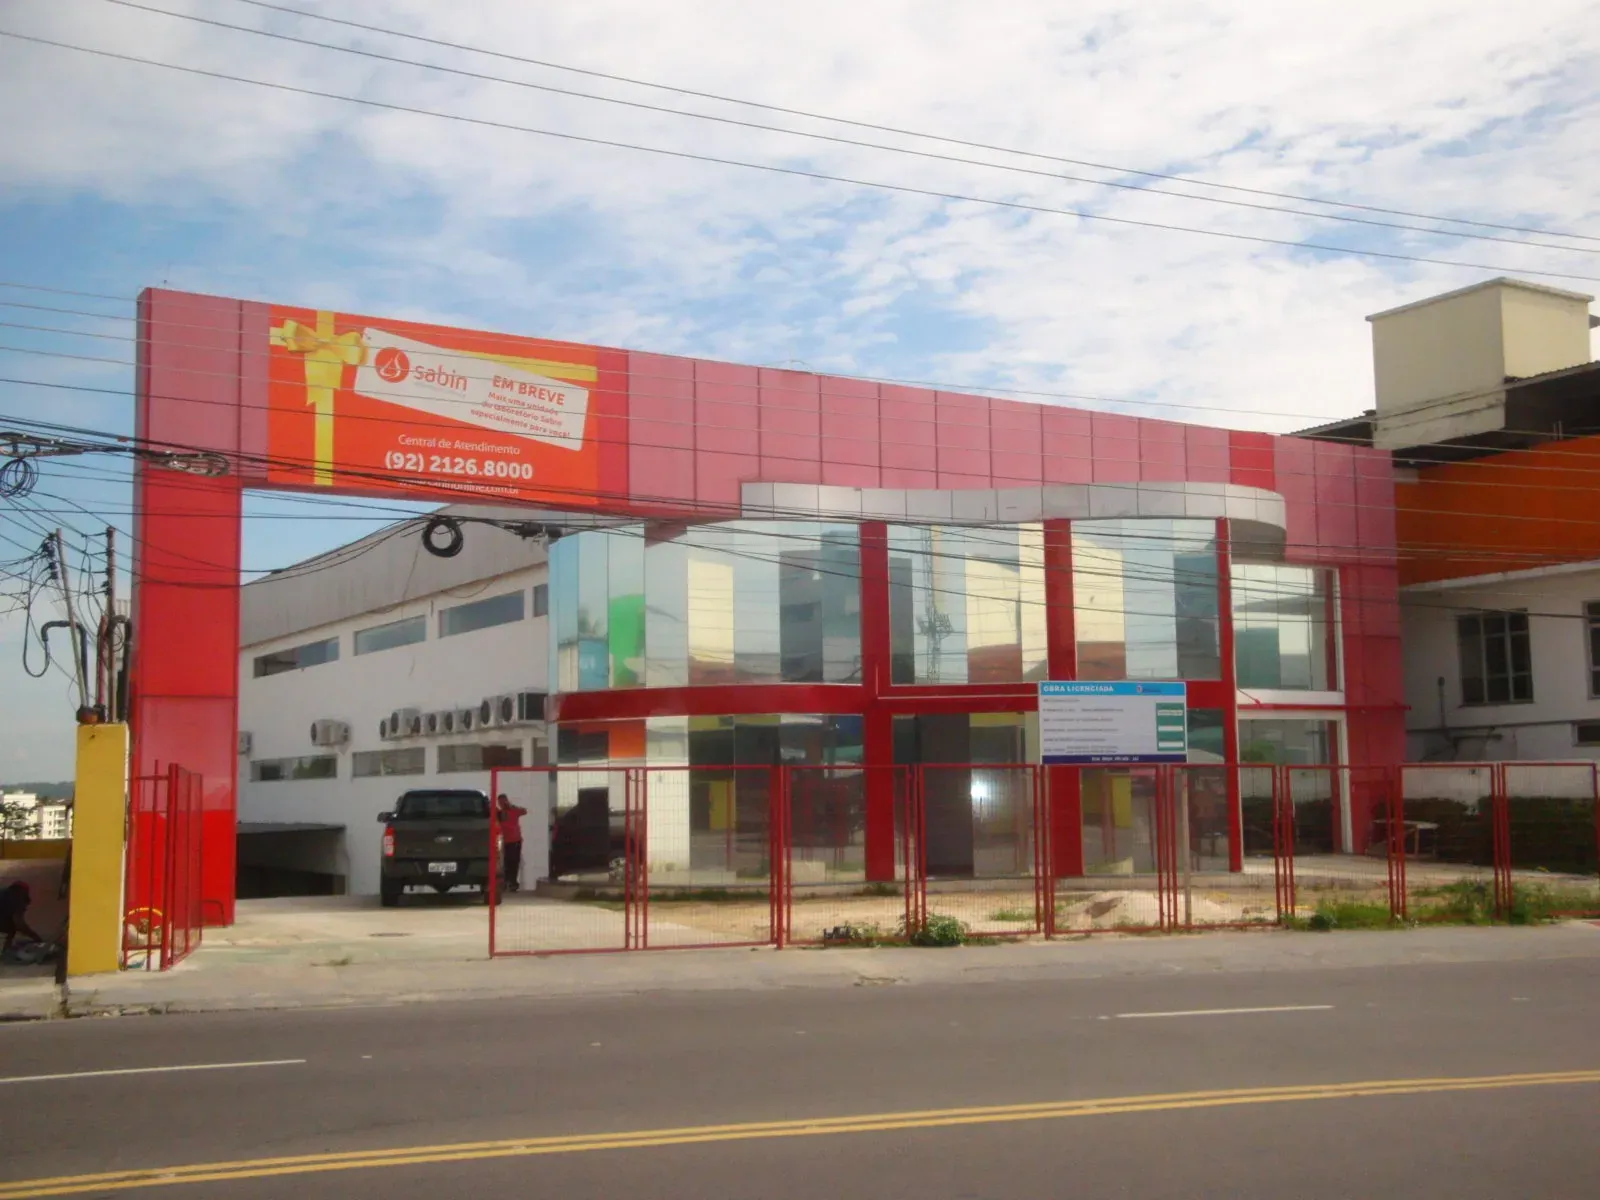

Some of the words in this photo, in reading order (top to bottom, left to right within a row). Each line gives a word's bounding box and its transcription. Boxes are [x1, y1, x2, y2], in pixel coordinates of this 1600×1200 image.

[413, 363, 467, 391] sabin
[492, 375, 514, 391] EM
[518, 382, 565, 406] BREVE
[507, 398, 525, 407] uma
[398, 434, 436, 448] Central
[438, 438, 451, 449] de
[453, 439, 520, 456] Atendimento
[385, 451, 424, 472] (92)
[429, 455, 533, 480] 2126.8000
[1067, 684, 1114, 693] LICENCIADA
